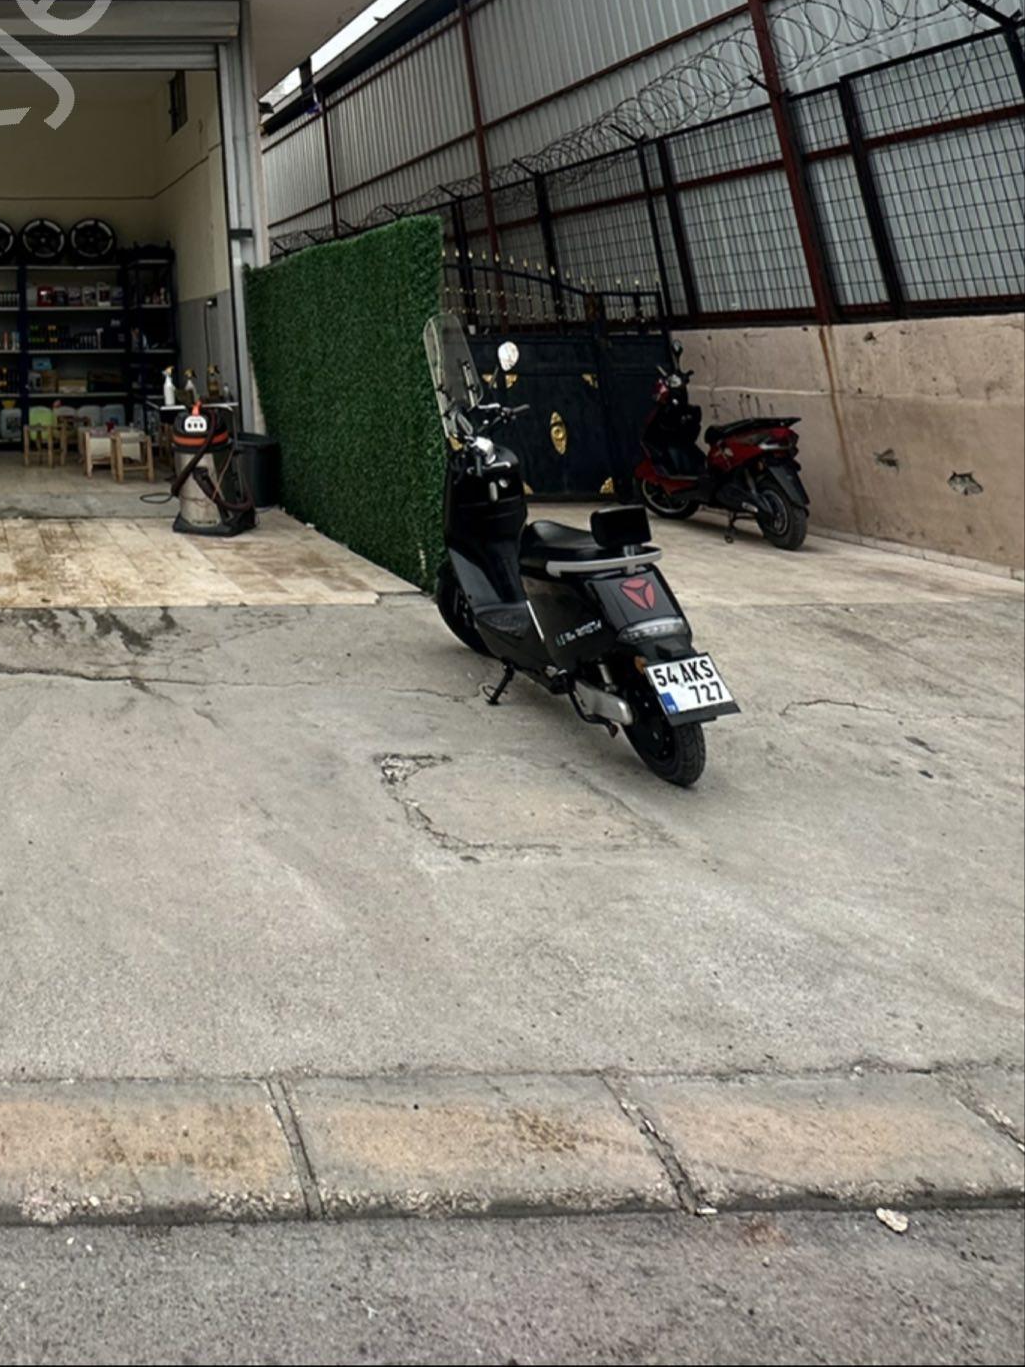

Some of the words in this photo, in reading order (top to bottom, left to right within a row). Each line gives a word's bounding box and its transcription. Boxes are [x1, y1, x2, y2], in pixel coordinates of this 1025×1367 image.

[653, 666, 679, 686] 54
[679, 659, 714, 683] AKS
[688, 682, 724, 704] 727
